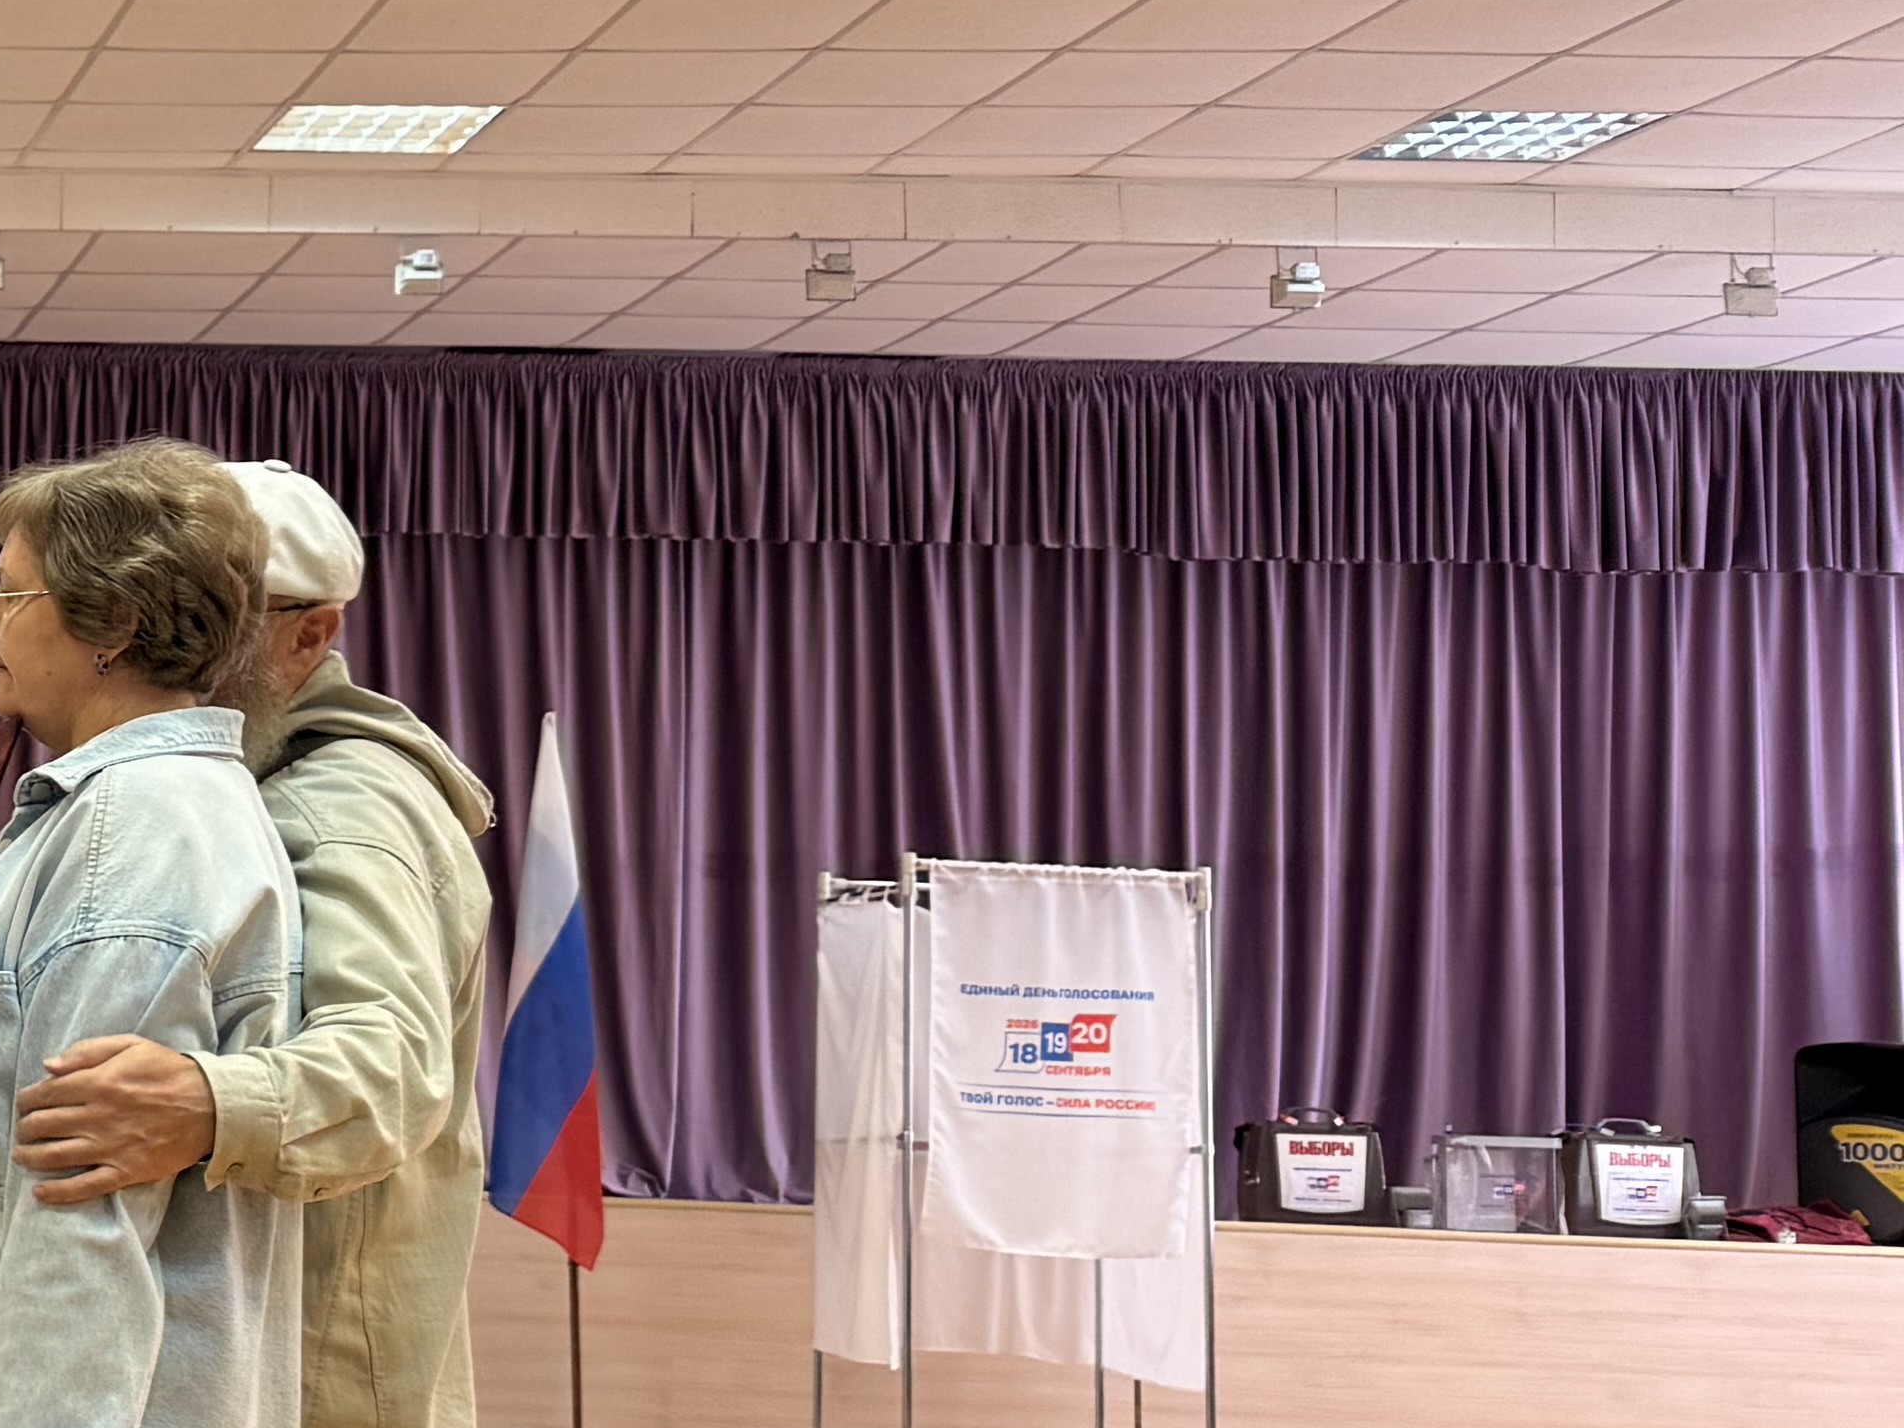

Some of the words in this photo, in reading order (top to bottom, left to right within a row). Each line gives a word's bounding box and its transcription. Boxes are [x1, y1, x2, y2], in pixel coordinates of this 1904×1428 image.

[959, 983, 1020, 997] ЕДИНЫЙ
[1023, 987, 1057, 998] ДЕНЬ
[1060, 989, 1155, 1001] ГОЛОСОВАНИЯ
[1008, 1043, 1038, 1064] 18
[1044, 1032, 1068, 1054] 19
[1072, 1023, 1107, 1044] 20
[1045, 1065, 1111, 1077] СЕНТЯБРЯ
[960, 1091, 993, 1104] ТВОЙ
[997, 1094, 1044, 1107] ГОЛОС
[1056, 1097, 1091, 1109] СИЛА
[1288, 1140, 1354, 1157] ВЫБОРЫ
[1841, 1142, 1904, 1162] 1000
[1609, 1152, 1671, 1168] ВЫБОРЫ
